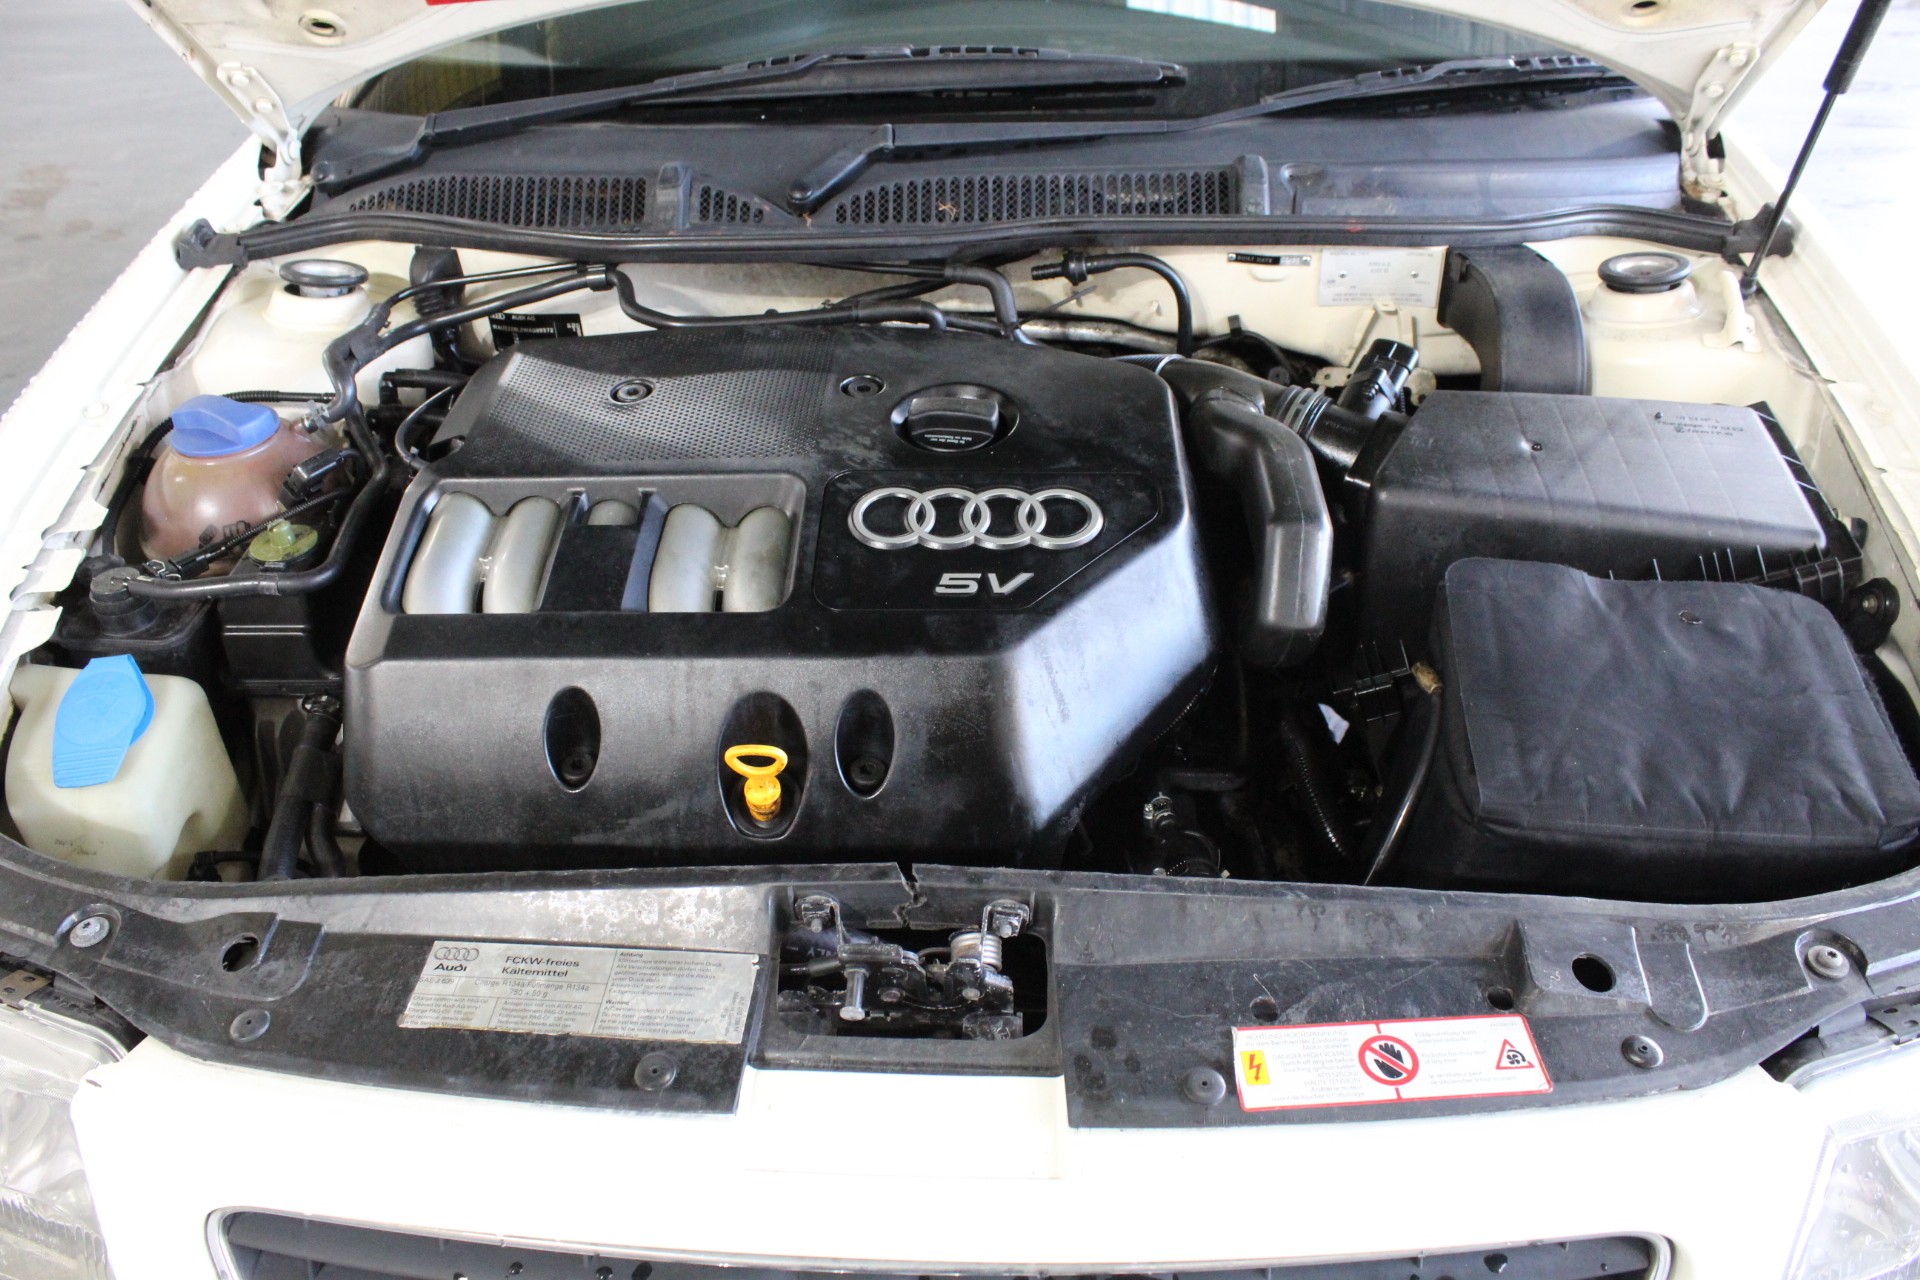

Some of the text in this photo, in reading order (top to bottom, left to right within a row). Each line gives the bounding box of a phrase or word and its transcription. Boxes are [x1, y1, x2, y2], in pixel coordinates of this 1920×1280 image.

[934, 572, 1035, 597] 5V
[505, 955, 580, 968] FCKW-freies
[433, 963, 468, 972] Audi
[501, 966, 569, 977] Kältemittel
[474, 979, 500, 987] Charge
[566, 983, 590, 992] R134a
[532, 989, 542, 997] 50
[1284, 1029, 1347, 1039] HOCHSPANNUNG
